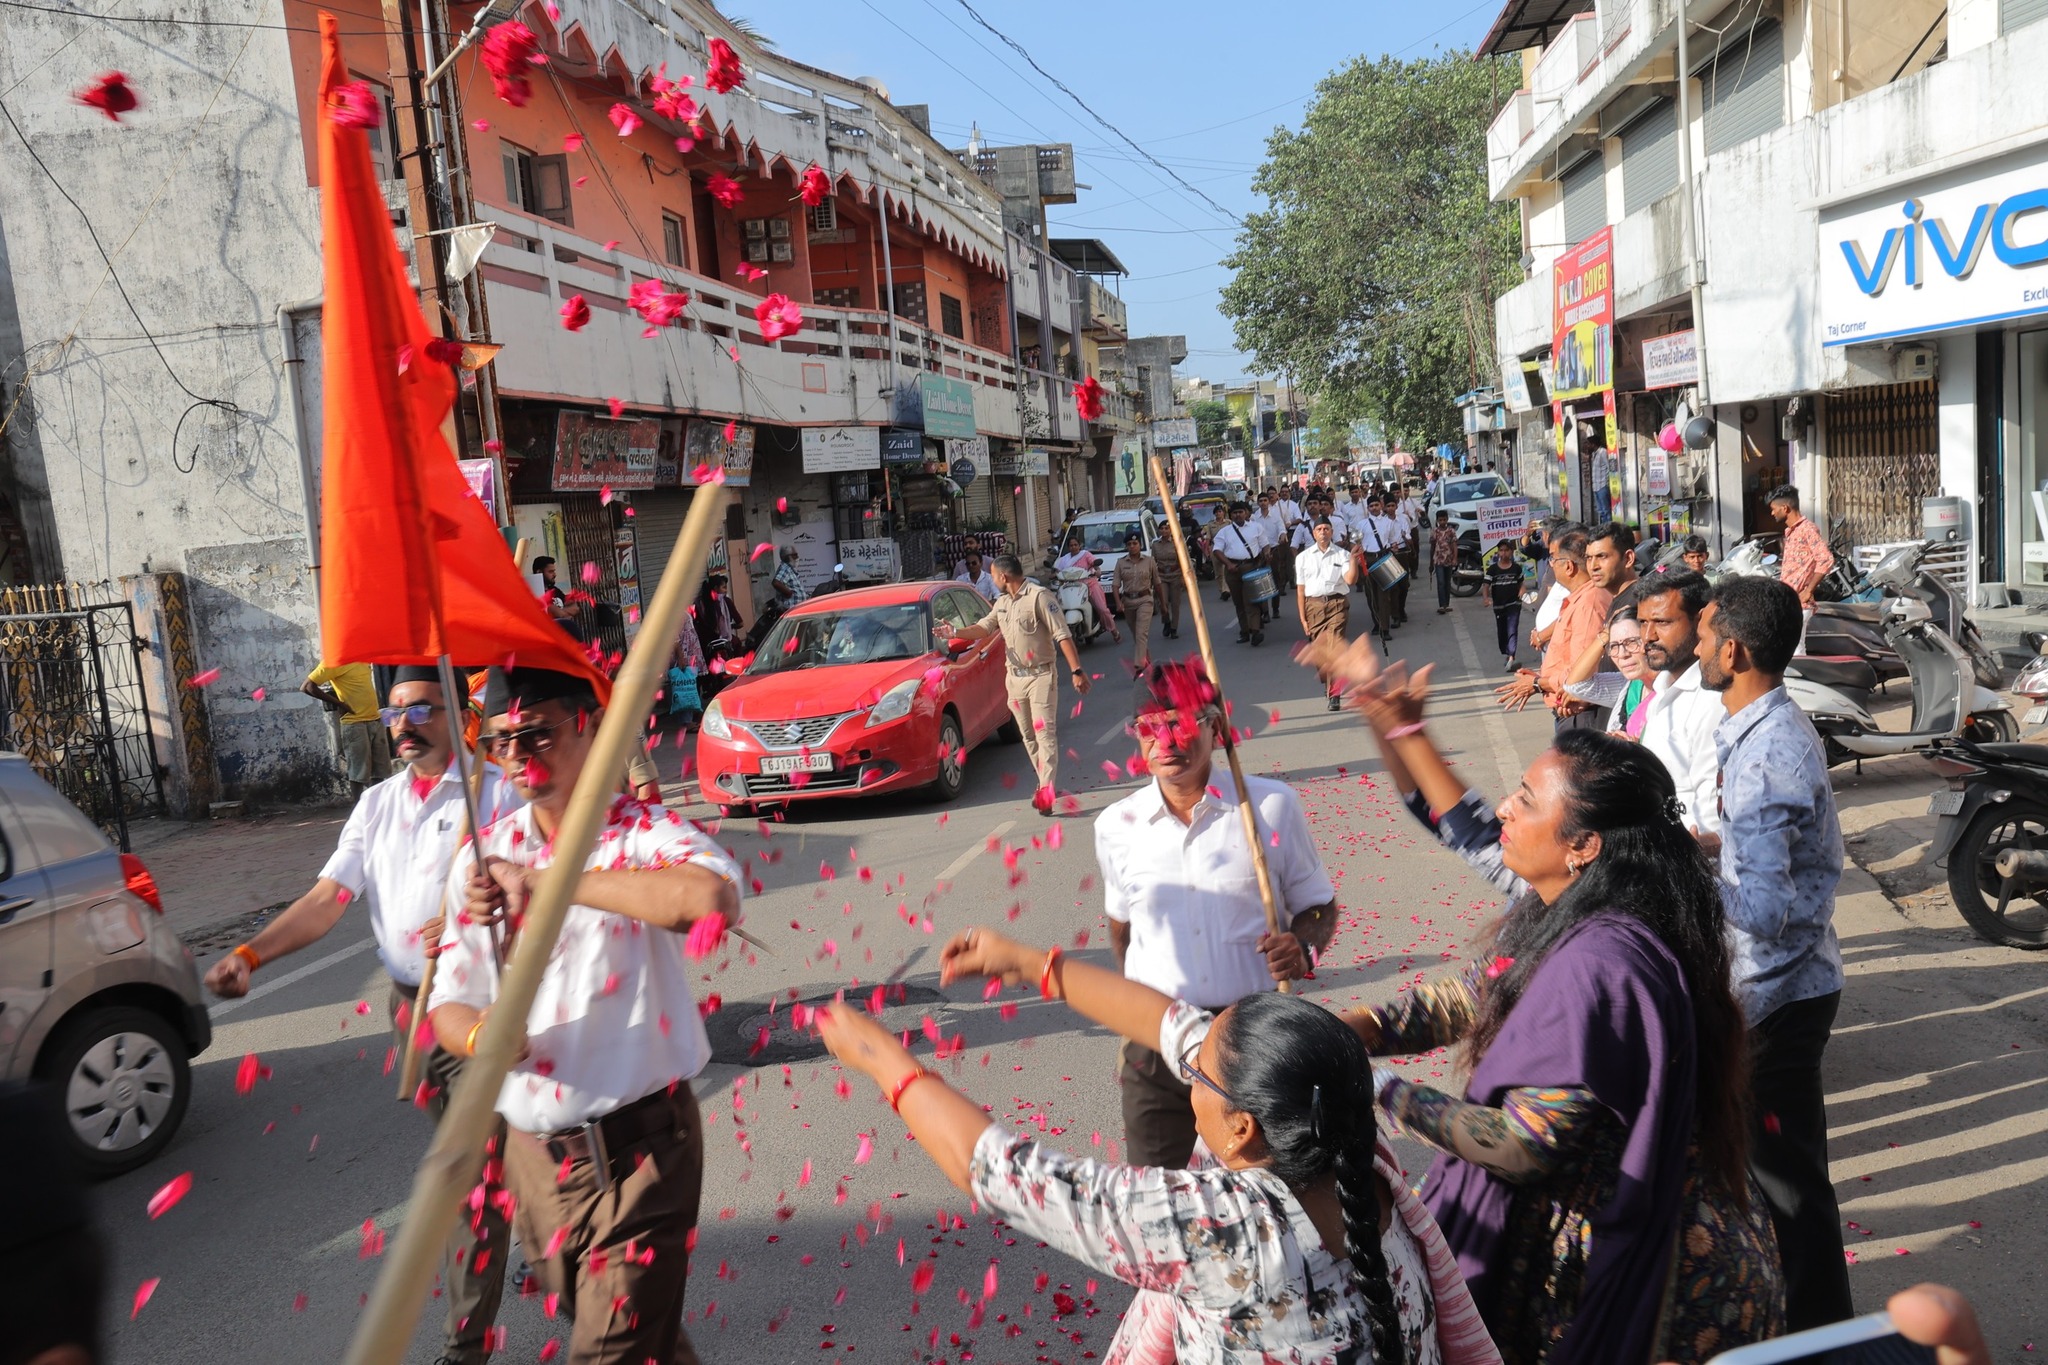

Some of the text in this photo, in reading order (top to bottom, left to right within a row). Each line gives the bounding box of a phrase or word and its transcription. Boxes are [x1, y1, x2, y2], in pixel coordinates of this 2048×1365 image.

[1840, 188, 2048, 296] vivo
[1559, 261, 1608, 310] WORLD COVER
[1828, 321, 1867, 336] Taj Corner
[888, 440, 914, 449] Zaid
[1486, 518, 1522, 530] तत्काल
